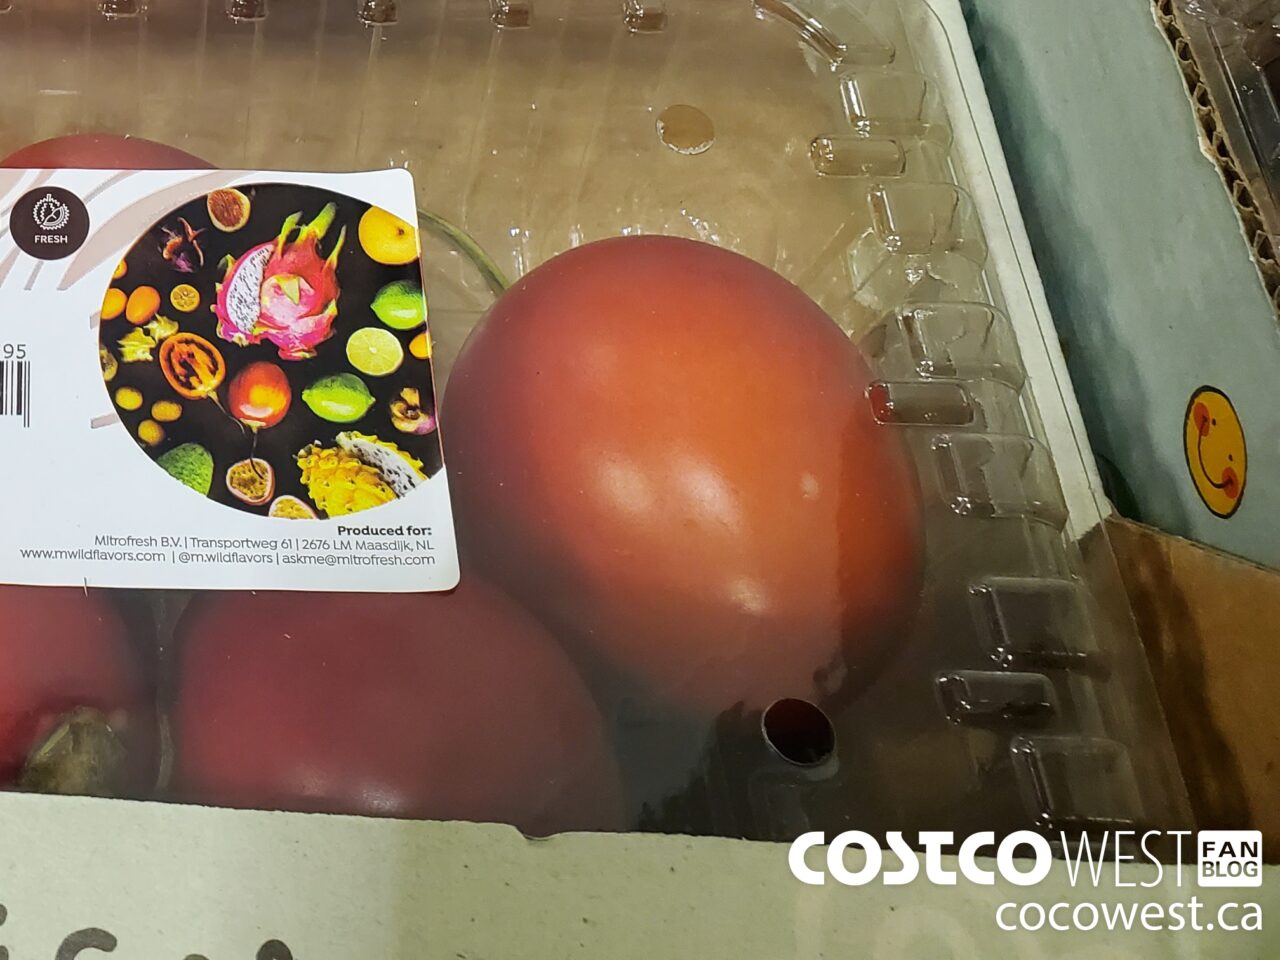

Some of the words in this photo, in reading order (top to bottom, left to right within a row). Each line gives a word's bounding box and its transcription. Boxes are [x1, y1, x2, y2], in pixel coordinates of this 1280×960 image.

[33, 235, 69, 245] FRESH
[337, 525, 404, 537] Produced
[407, 525, 432, 537] for:
[94, 535, 158, 547] Mitrofresh
[161, 536, 183, 548] B.V.
[190, 536, 278, 551] Transportweg
[280, 539, 293, 550] 61
[302, 539, 331, 551] 2676
[333, 540, 351, 551] LM
[416, 540, 435, 551] NL
[19, 548, 166, 562] www.mwildflavors.com
[178, 550, 273, 564] @m.wildflavors
[282, 553, 436, 567] askme@mitrofresh.com
